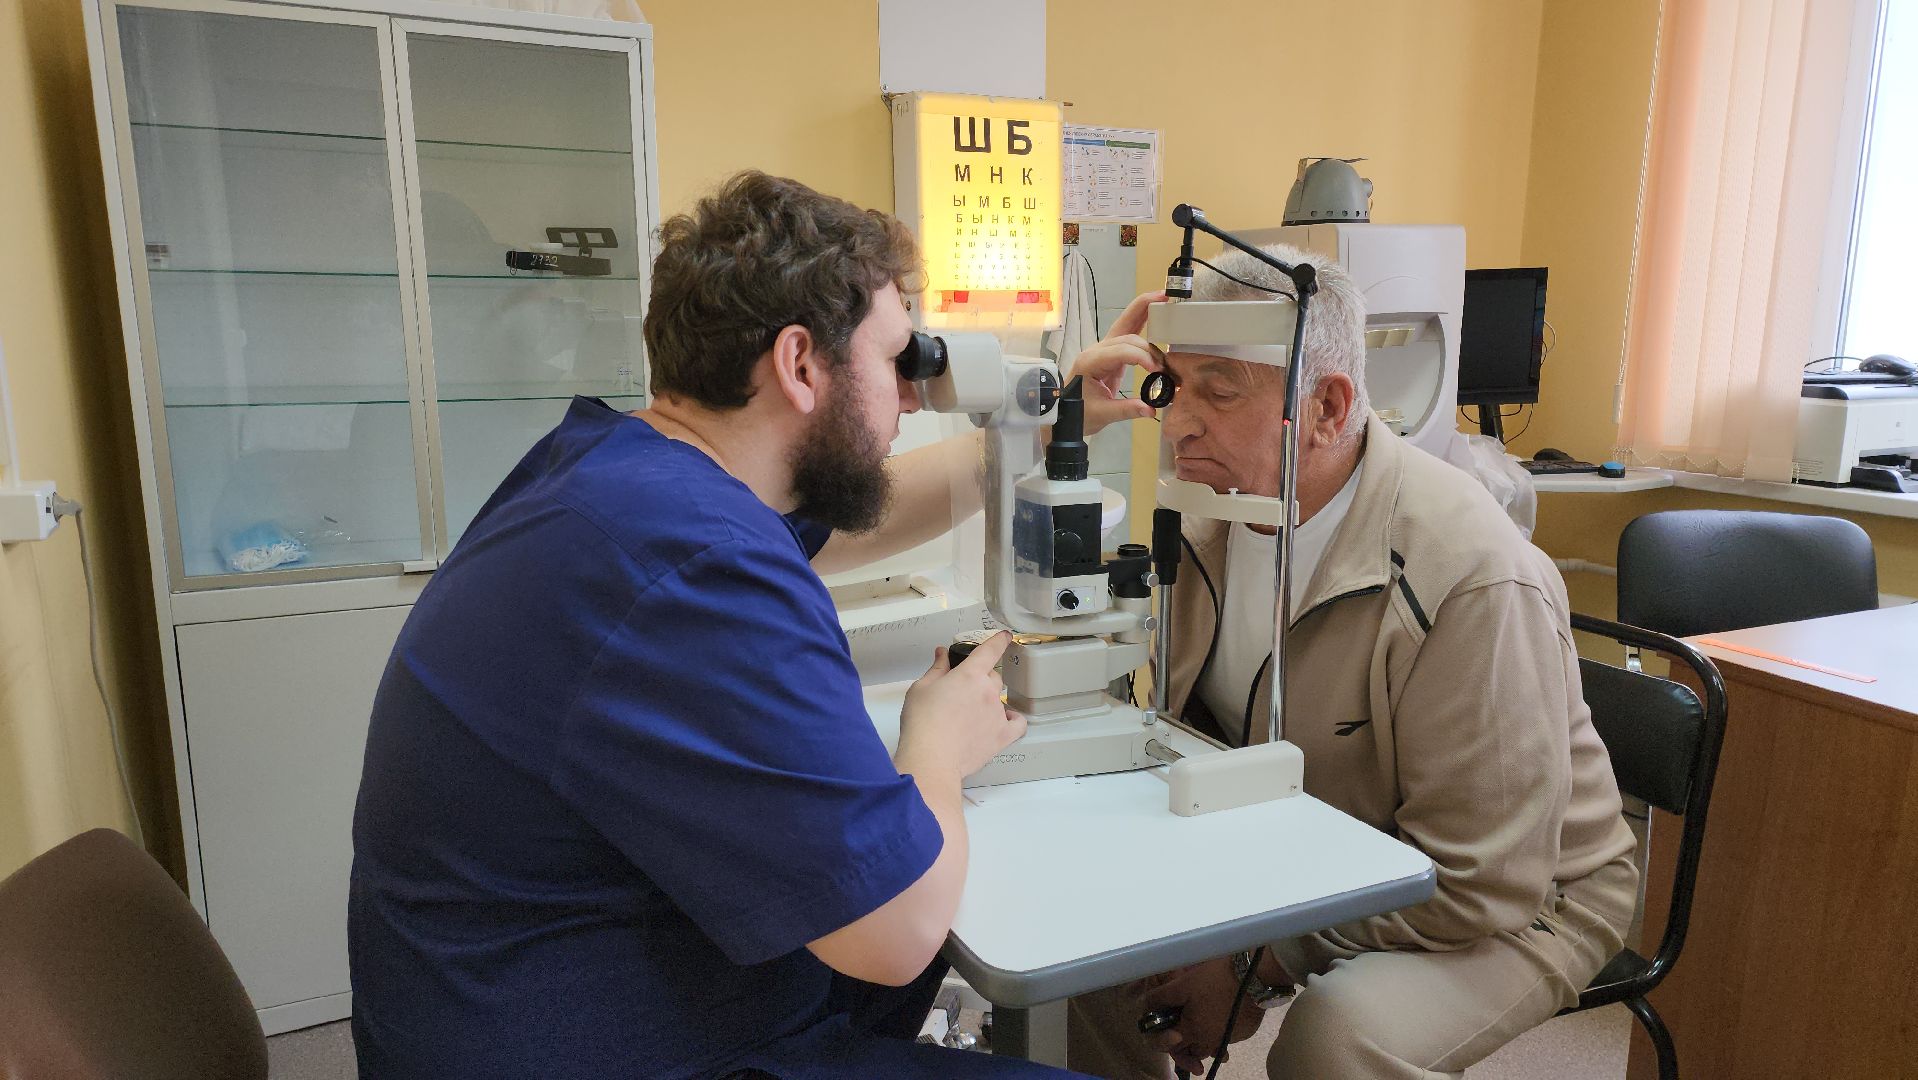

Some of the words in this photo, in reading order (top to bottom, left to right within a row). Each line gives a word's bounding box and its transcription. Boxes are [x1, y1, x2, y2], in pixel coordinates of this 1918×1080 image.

[954, 116, 991, 153] Ш
[1007, 120, 1032, 155] Б
[955, 163, 970, 182] М
[990, 165, 1003, 184] Н
[1022, 167, 1032, 185] К
[953, 195, 966, 207] Ы
[979, 195, 990, 208] М
[1002, 196, 1011, 209] Б
[1024, 197, 1036, 210] Ш
[956, 213, 963, 223] Б
[972, 213, 983, 224] Ы
[991, 214, 999, 224] Н
